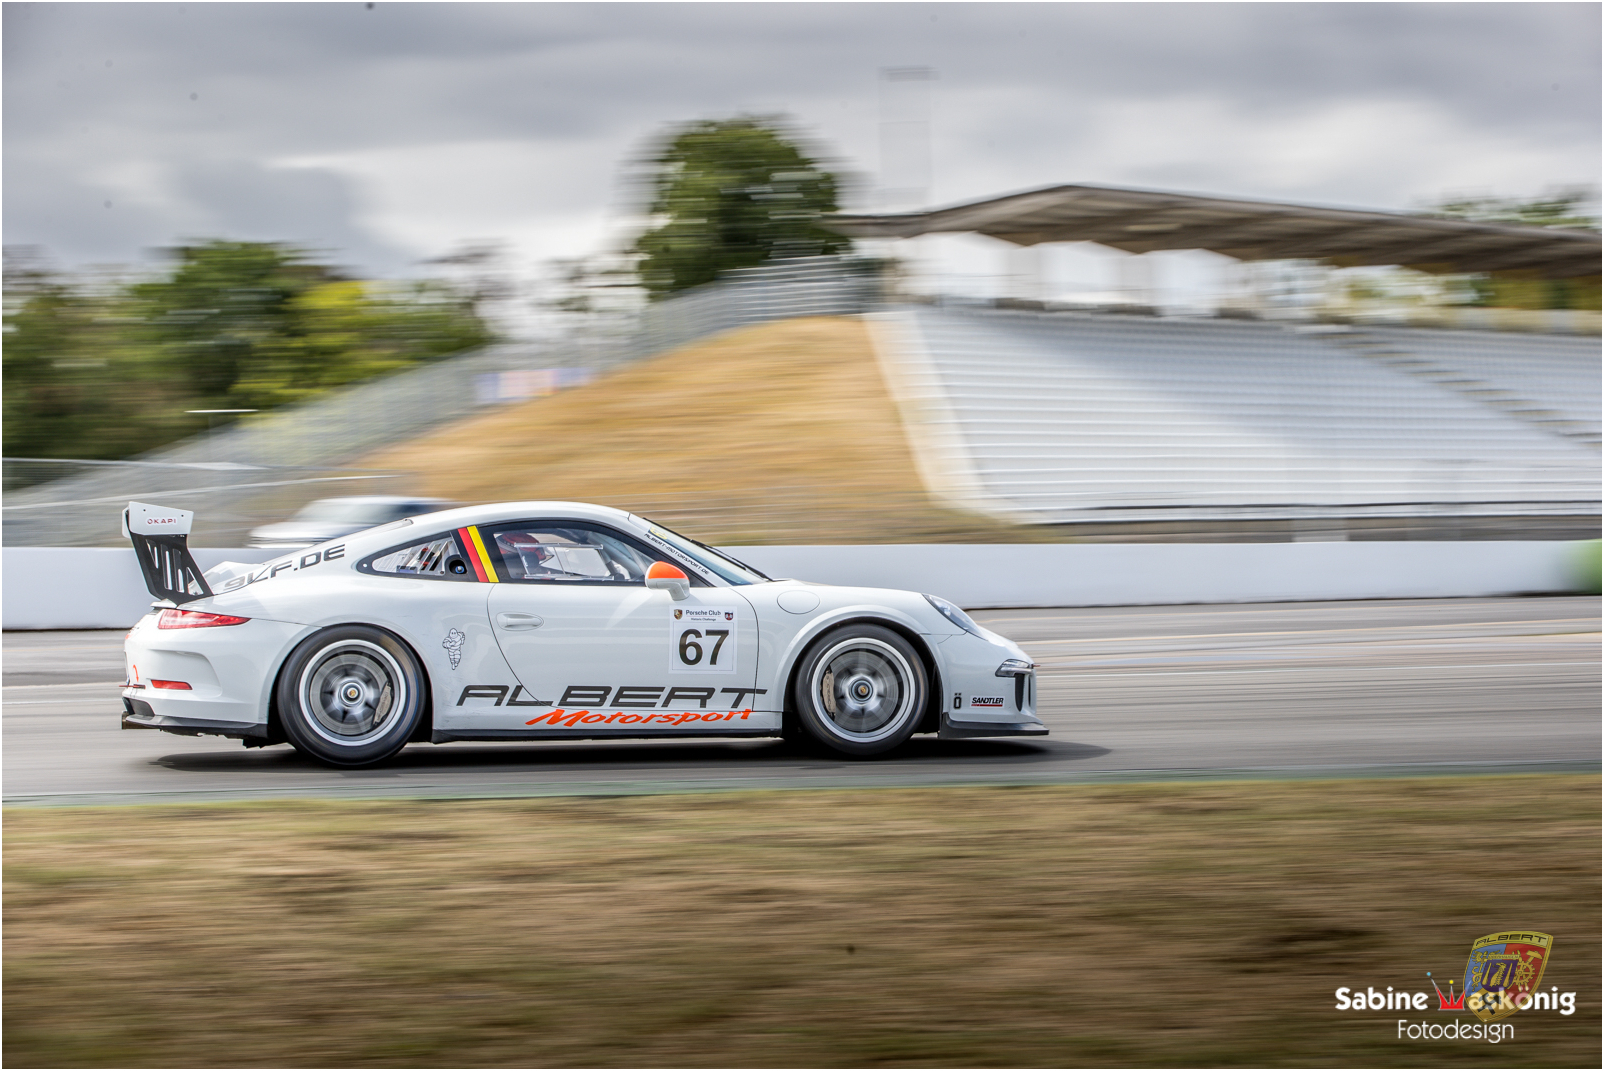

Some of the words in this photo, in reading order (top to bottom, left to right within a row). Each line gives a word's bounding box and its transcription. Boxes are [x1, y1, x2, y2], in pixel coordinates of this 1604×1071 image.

[678, 628, 730, 666] 67
[455, 684, 769, 709] ALBERT
[525, 708, 753, 728] Motorsport
